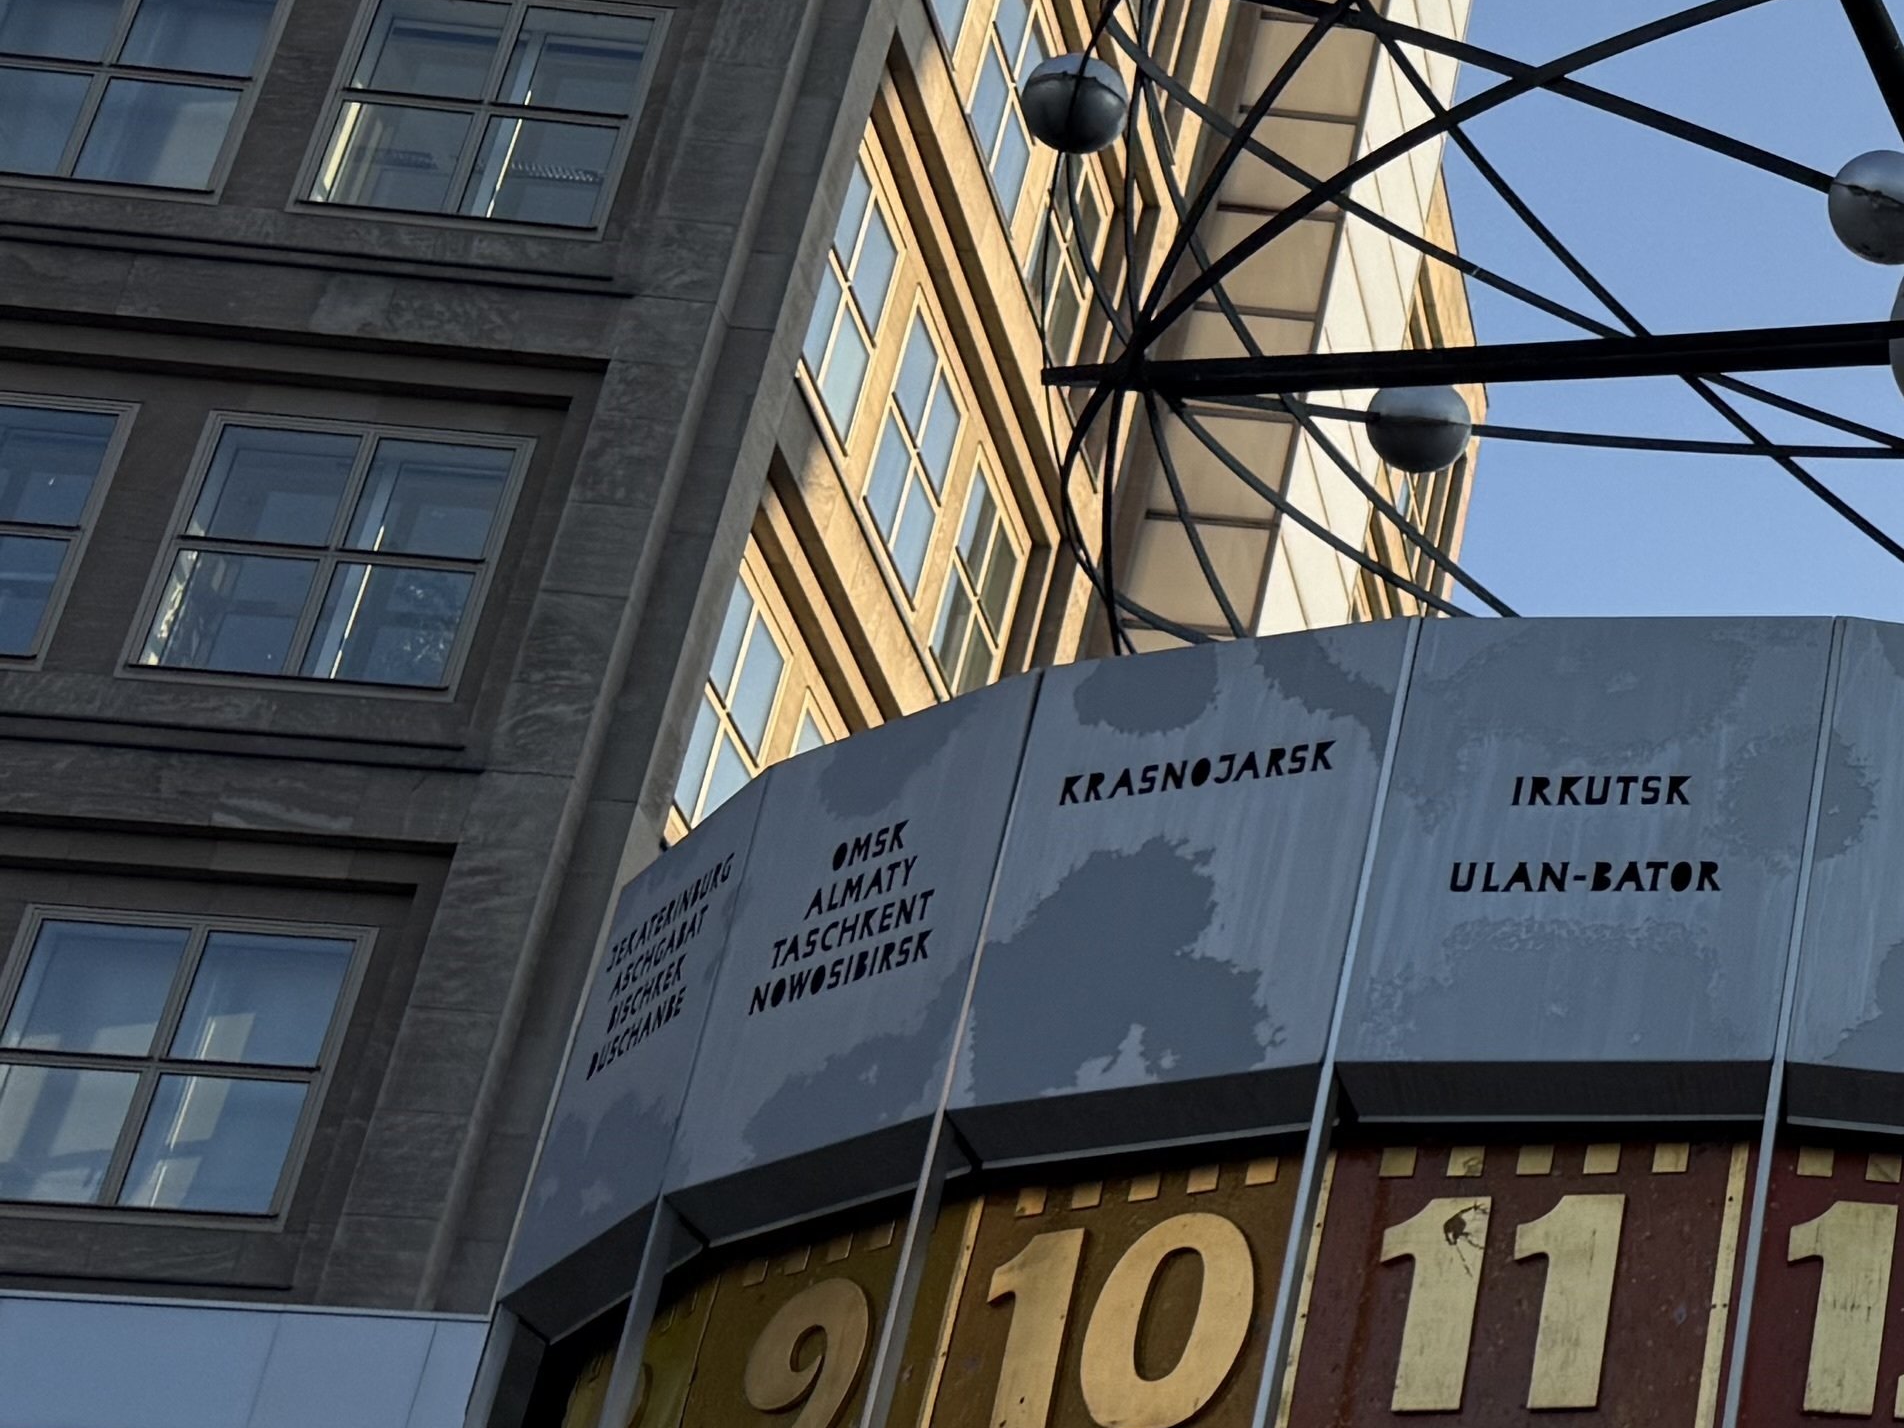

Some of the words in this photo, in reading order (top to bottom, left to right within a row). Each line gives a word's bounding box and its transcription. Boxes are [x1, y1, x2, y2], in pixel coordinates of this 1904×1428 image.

[1058, 740, 1336, 806] KRASNOJARSK
[1510, 775, 1692, 807] IRKUTSK
[833, 819, 909, 871] OMSK
[1449, 860, 1721, 893] ULAN-BATOR
[804, 855, 917, 920] ALMATY
[771, 889, 934, 969] TASCHKENT
[749, 929, 933, 1015] NOWOSIBIRSK
[1381, 1193, 1626, 1412] 11
